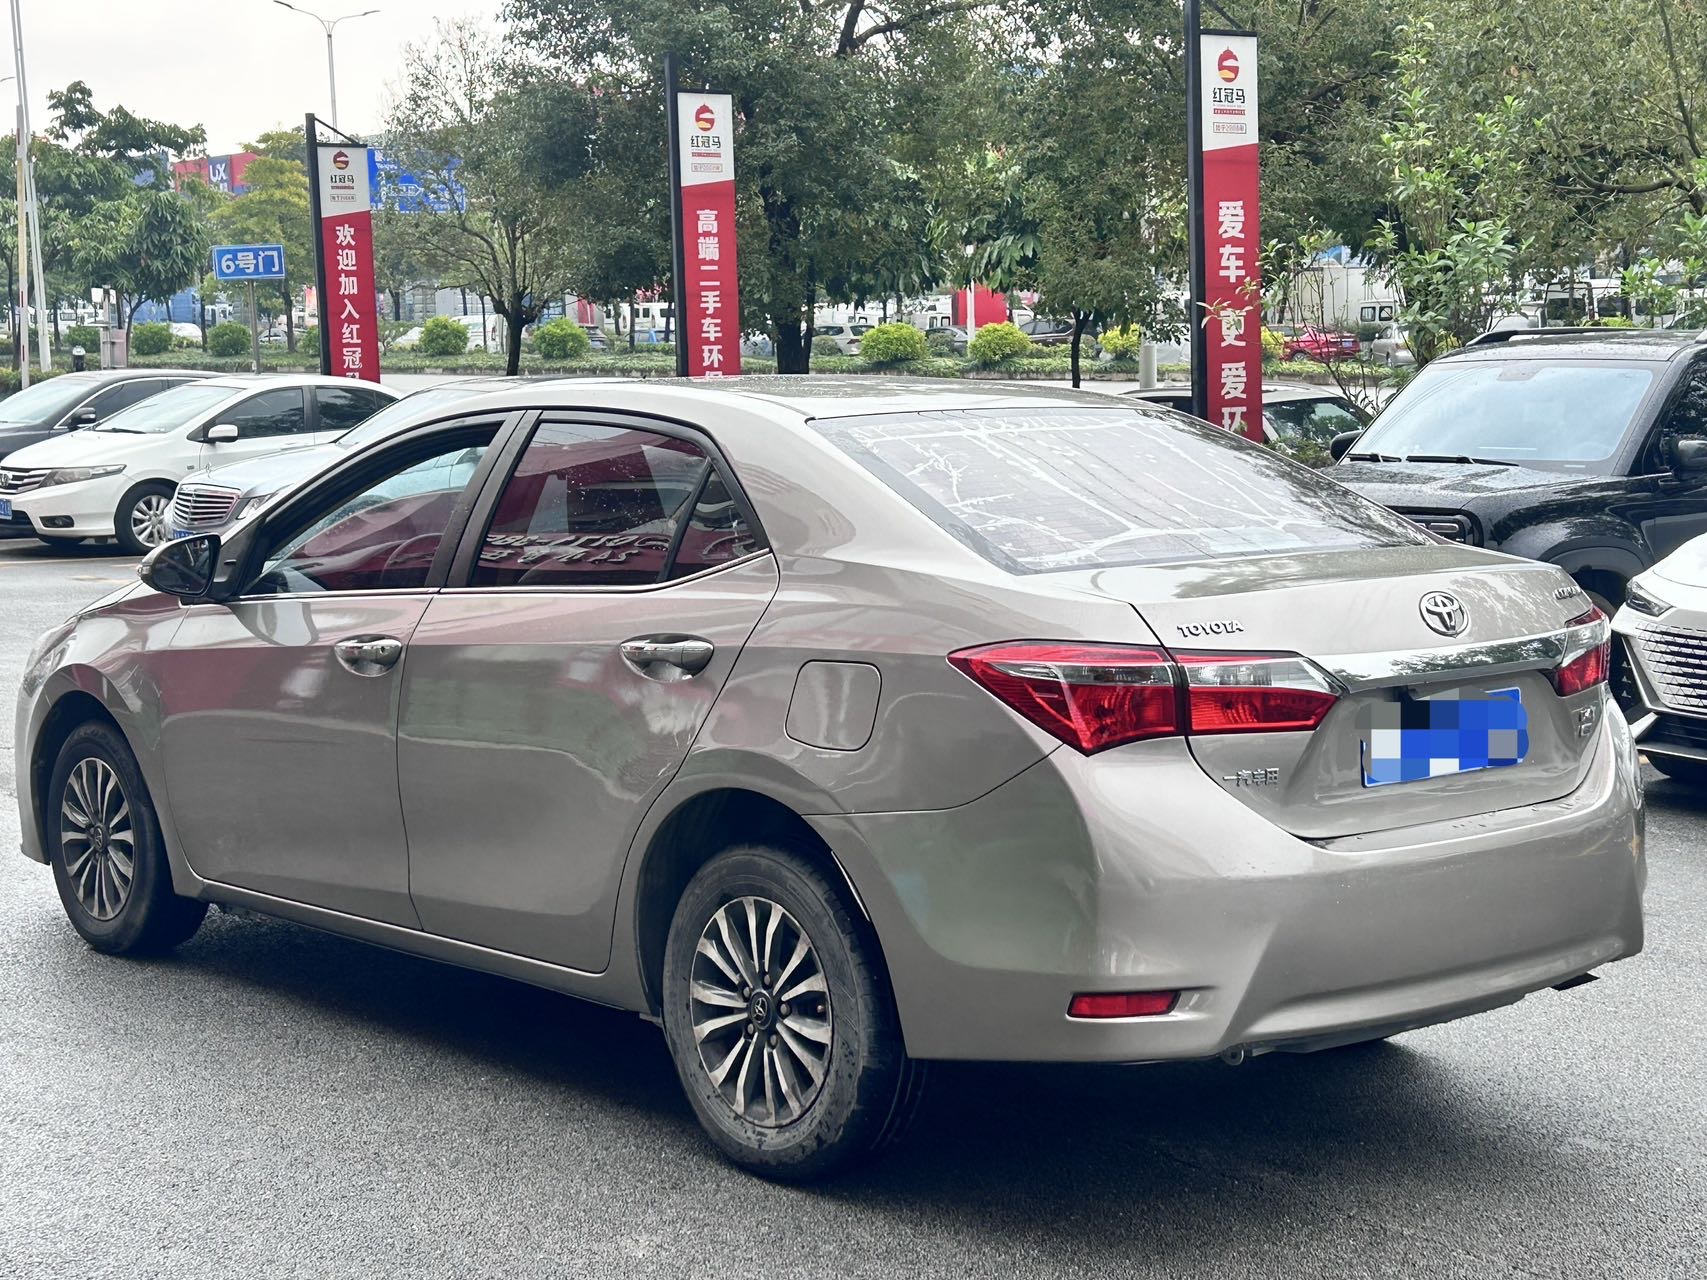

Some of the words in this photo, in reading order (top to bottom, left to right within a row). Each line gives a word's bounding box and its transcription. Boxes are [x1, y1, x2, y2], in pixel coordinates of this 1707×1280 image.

[1213, 87, 1246, 104] 红冠马
[690, 135, 722, 149] 红冠马
[220, 251, 280, 274] 6号门
[696, 209, 724, 377] 高端二手车环
[1177, 619, 1245, 638] TOYOTA
[1223, 767, 1280, 787] 一汽丰田
